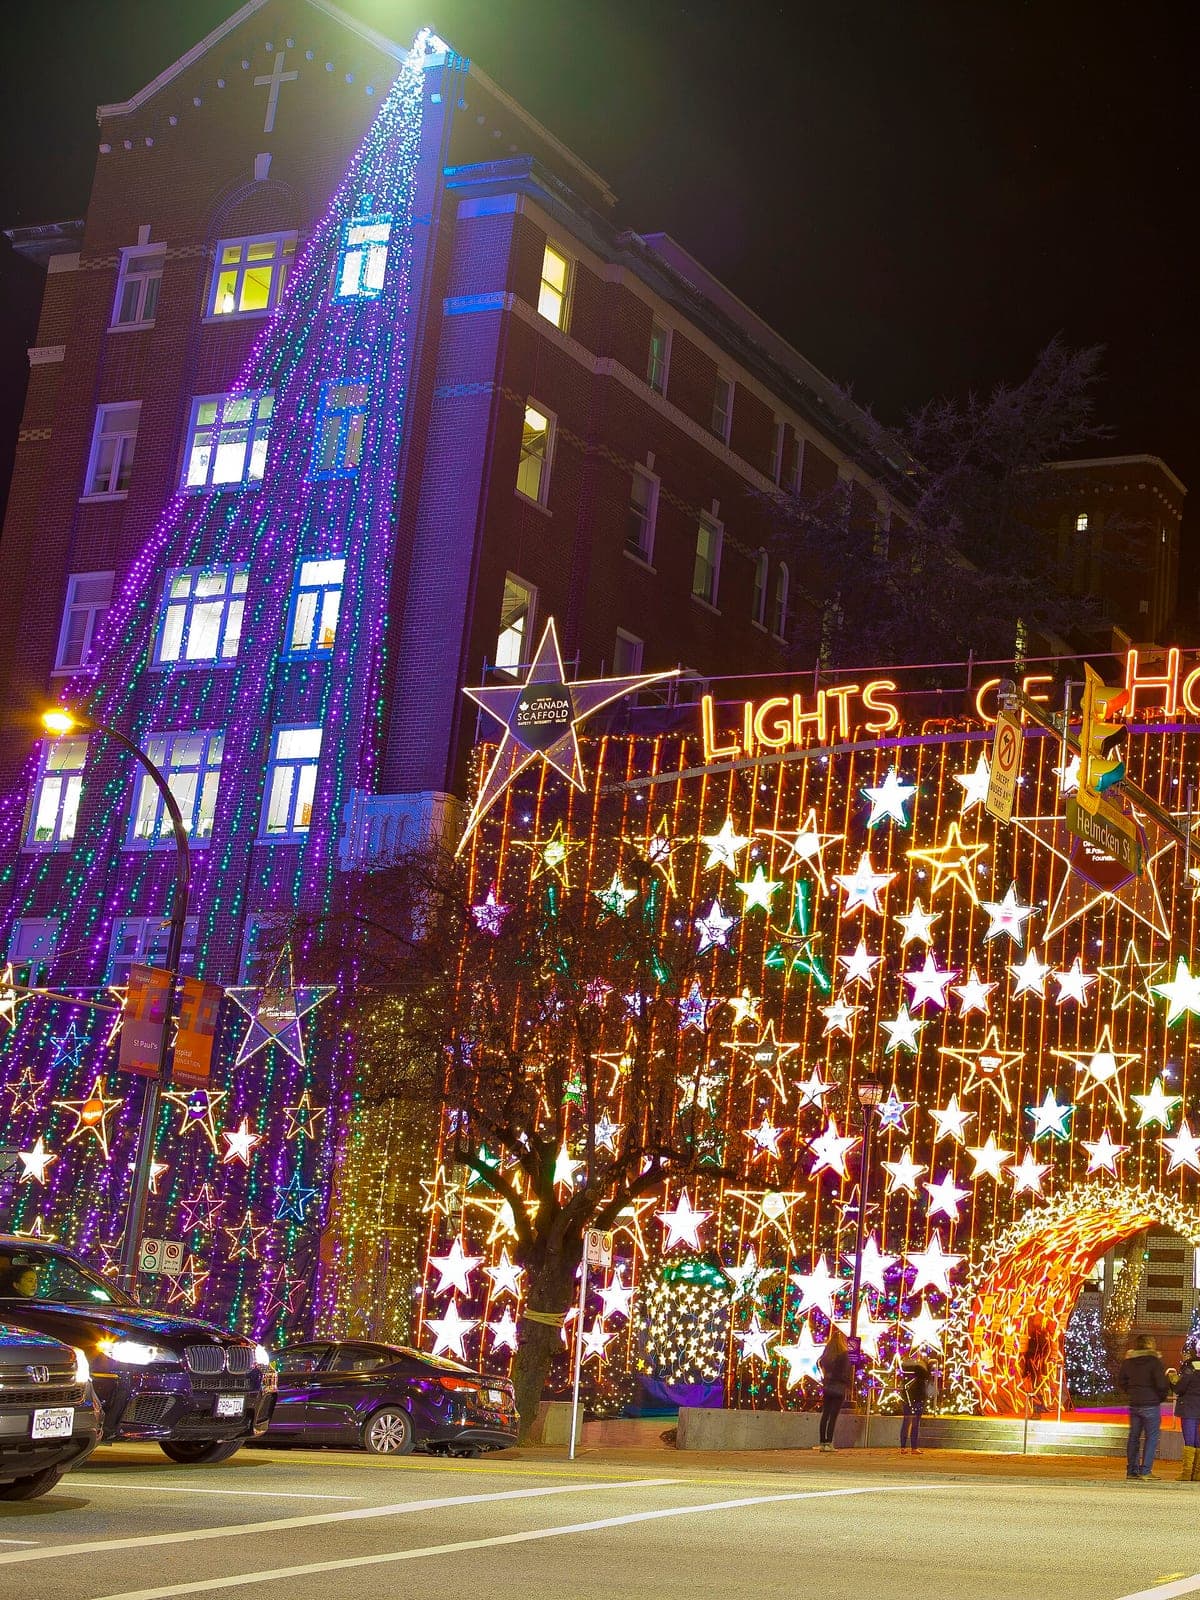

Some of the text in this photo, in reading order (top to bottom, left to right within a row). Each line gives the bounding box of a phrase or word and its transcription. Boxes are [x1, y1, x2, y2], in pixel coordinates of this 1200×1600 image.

[517, 709, 569, 721] SCAFFOLD
[530, 700, 569, 711] CANADA
[701, 680, 899, 760] LIGHTS
[1077, 807, 1120, 855] Helmcken
[1122, 838, 1131, 863] St
